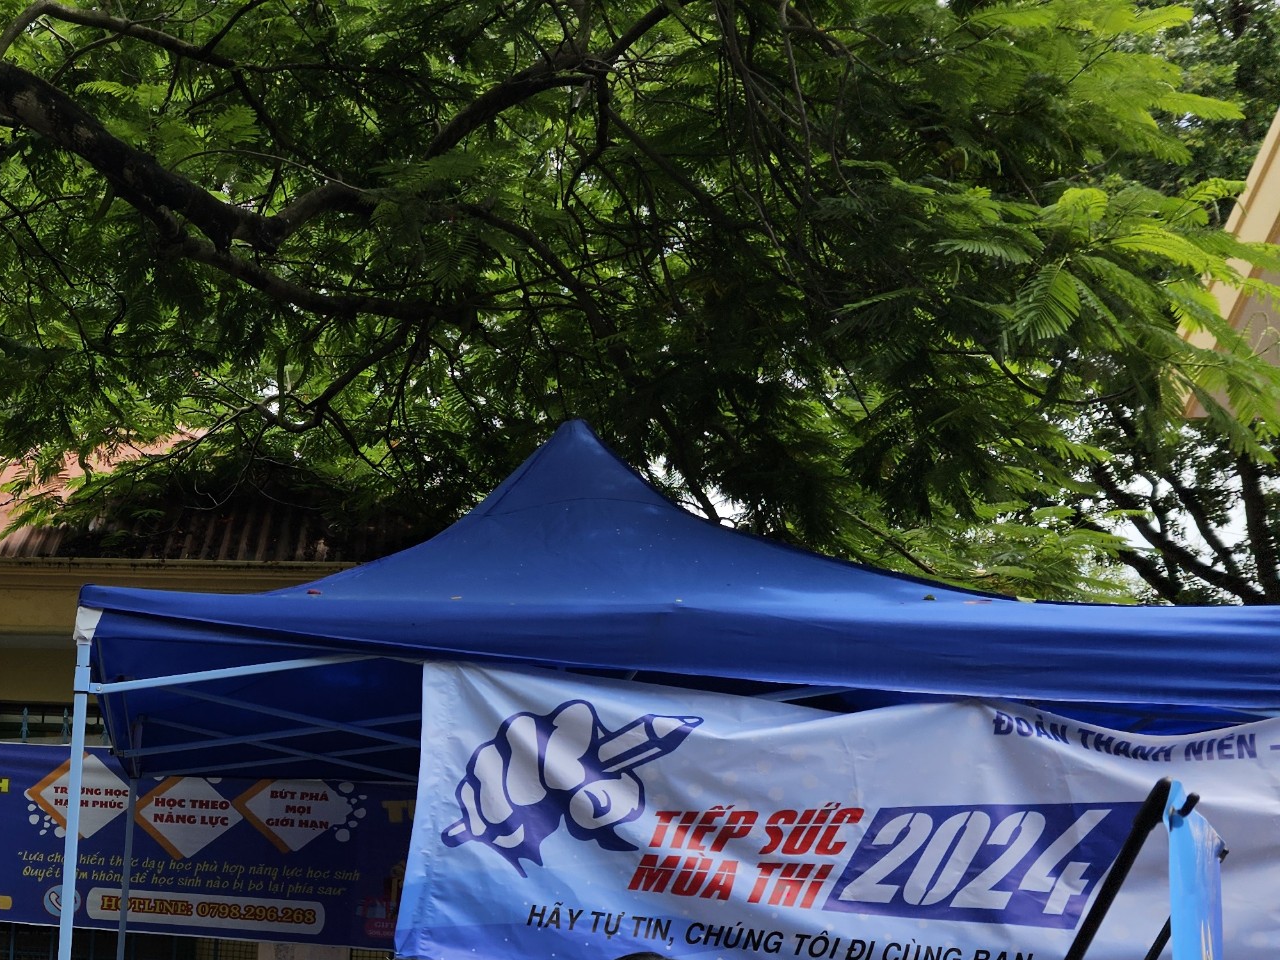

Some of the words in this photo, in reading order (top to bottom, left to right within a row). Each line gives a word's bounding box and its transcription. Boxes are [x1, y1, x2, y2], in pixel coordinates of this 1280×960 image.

[992, 710, 1070, 745] ĐOÀN
[1076, 727, 1176, 762] THANH
[1184, 733, 1258, 762] NIÊN
[54, 786, 101, 796] TRNG
[105, 789, 129, 797] HỌC
[270, 788, 297, 800] BÚT
[300, 790, 329, 801] PHÁ
[54, 798, 91, 809] HẠH
[92, 799, 124, 809] PHÚC
[154, 798, 185, 809] HỌC
[189, 799, 229, 810] THEO
[285, 805, 311, 815] MỌI
[153, 811, 197, 824] NĂNG
[200, 813, 229, 827] LỰC
[265, 817, 295, 828] GIỚI
[297, 820, 329, 830] HẠN
[648, 805, 759, 853] TIẾP
[759, 802, 865, 856] SỨC
[110, 854, 138, 867] thc
[169, 859, 192, 871] học
[195, 861, 218, 877] phù
[222, 861, 245, 879] hợp
[249, 863, 278, 880] năng
[306, 867, 330, 879] học
[334, 869, 360, 881] sinh
[838, 809, 1112, 915] 2024
[22, 864, 61, 882] Quyết
[152, 875, 174, 886] học
[178, 876, 201, 887] sinh
[206, 876, 229, 888] nào
[627, 851, 739, 901] MÙA
[747, 862, 835, 909] THI
[196, 902, 316, 924] 0798.296.268
[526, 902, 583, 931] HÃY
[590, 911, 625, 940] TỰ
[631, 916, 674, 946] TIN,
[685, 921, 784, 954] CHÚNG
[794, 930, 840, 958] TÔI
